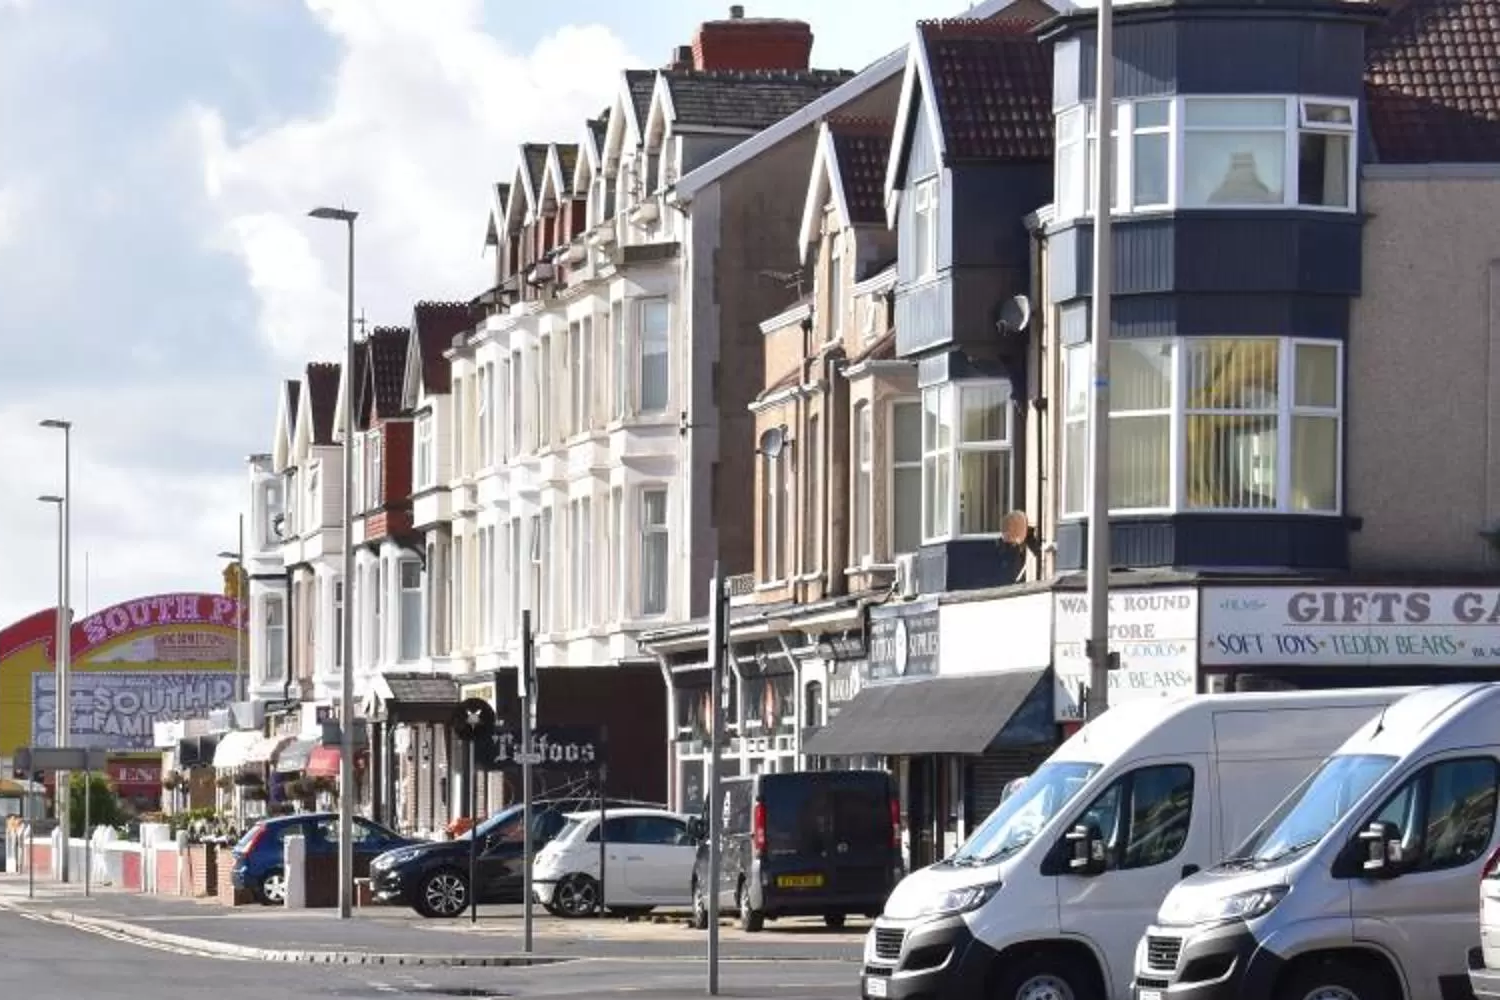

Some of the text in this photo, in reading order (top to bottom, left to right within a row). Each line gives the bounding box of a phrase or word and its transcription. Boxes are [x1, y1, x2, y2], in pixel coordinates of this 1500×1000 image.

[1060, 595, 1191, 613] WAK ROUND
[1288, 591, 1431, 623] GIFTS
[83, 595, 199, 645] SOUTH
[1107, 623, 1155, 639] TORE
[1217, 633, 1263, 655] SOFT
[1272, 633, 1319, 655] TOYS
[1328, 633, 1389, 656] TEDDY
[1395, 634, 1457, 656] BEARS
[1129, 671, 1186, 689] BEARS
[93, 680, 207, 713] SOUTH
[93, 711, 155, 736] FAMI
